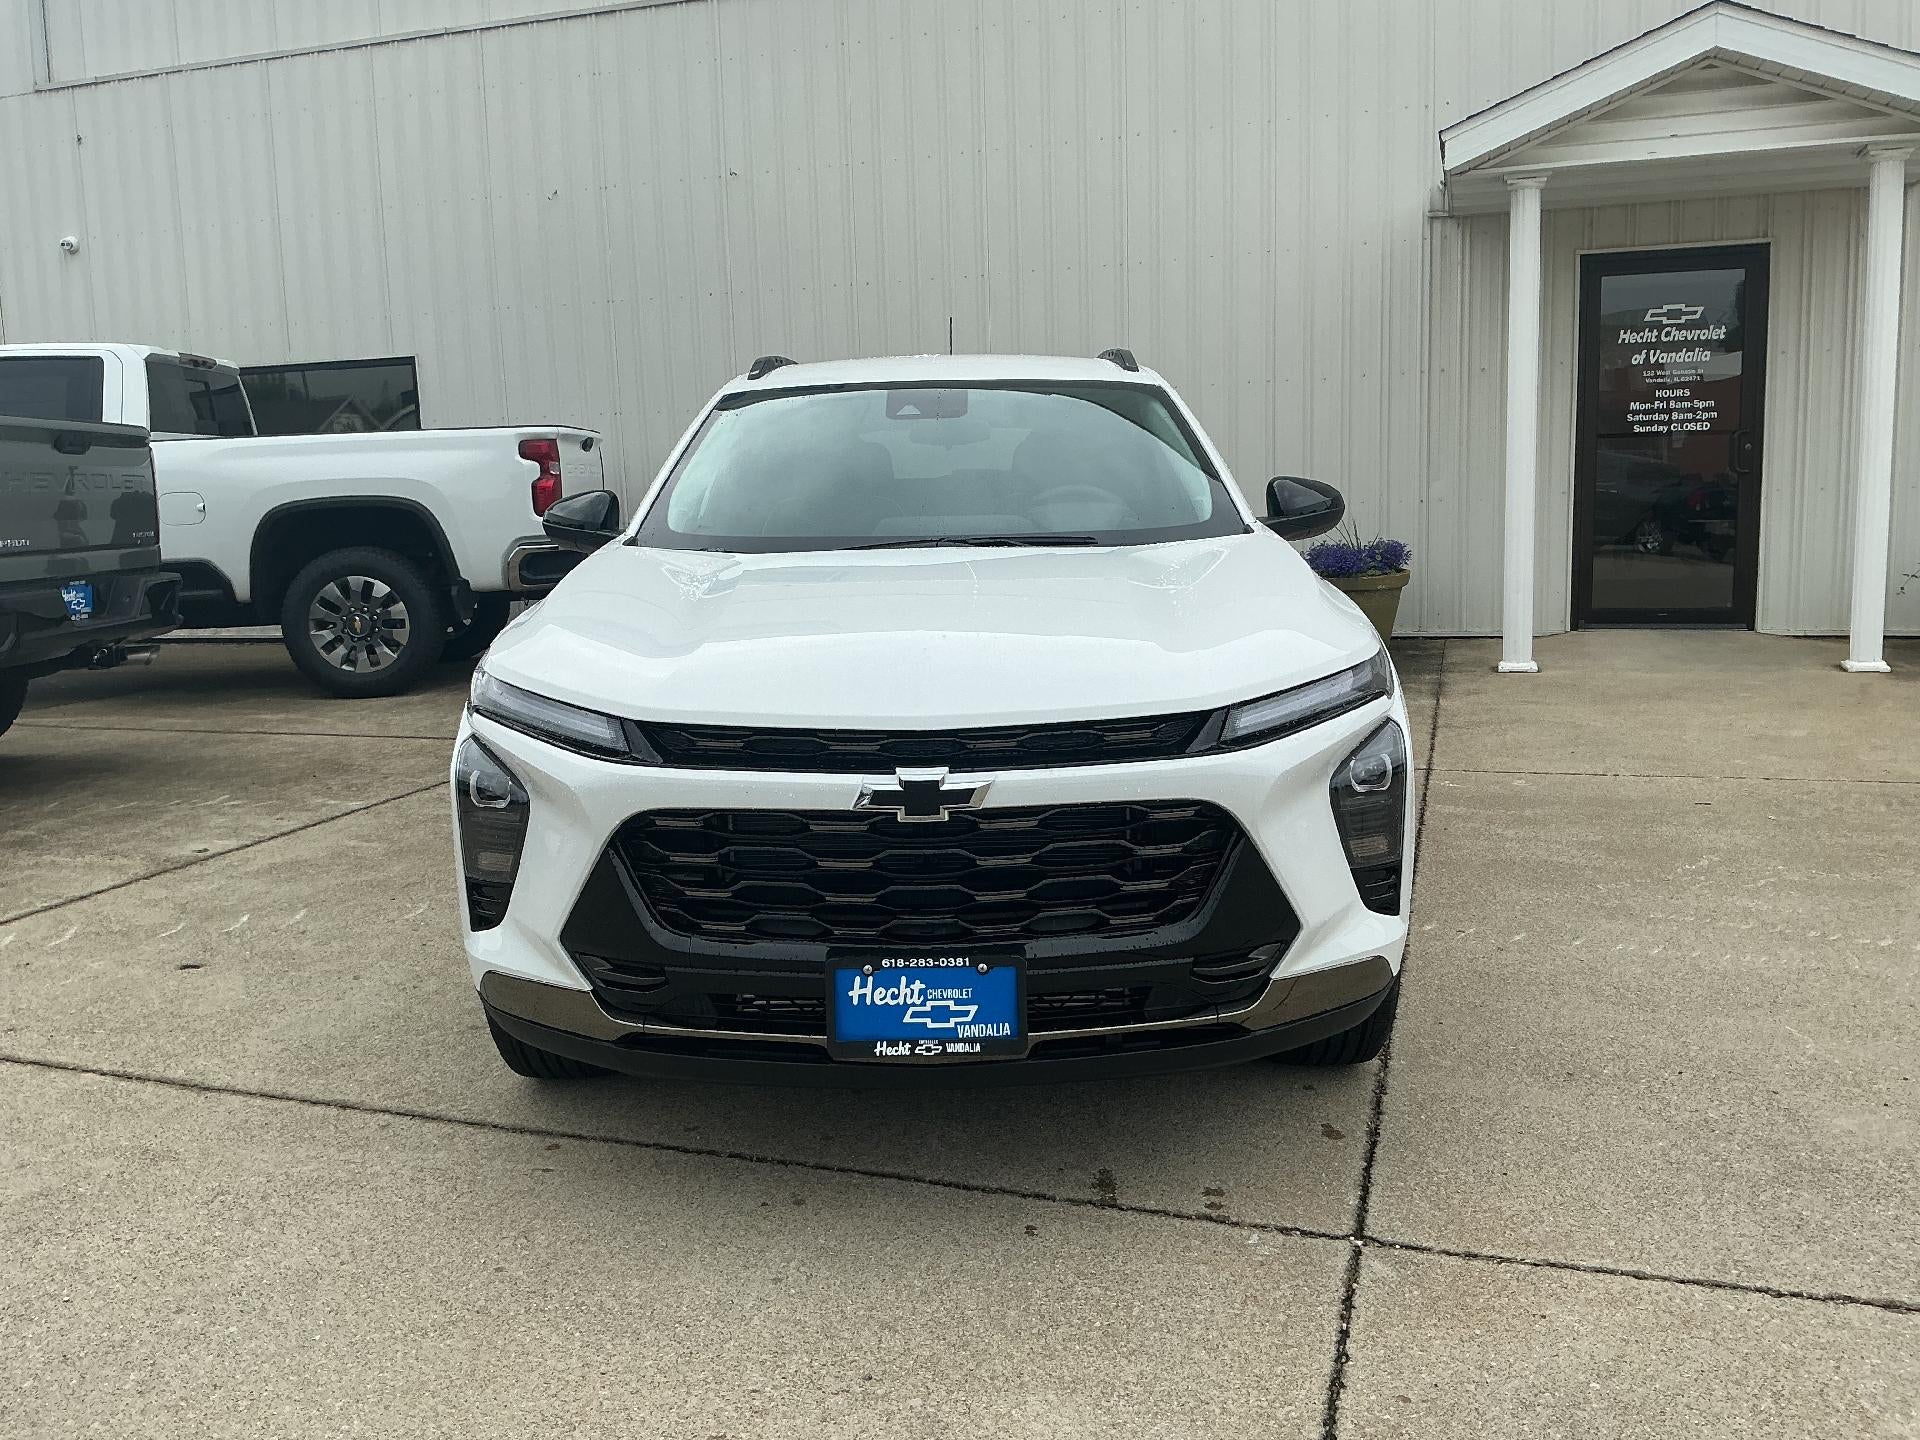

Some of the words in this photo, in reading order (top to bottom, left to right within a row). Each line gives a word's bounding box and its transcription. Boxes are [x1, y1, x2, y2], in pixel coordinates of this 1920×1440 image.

[1618, 328, 1659, 344] Hecht
[1661, 325, 1727, 342] Chevrolet
[1631, 349, 1647, 365] of
[1649, 348, 1711, 364] Vandalia
[1655, 388, 1691, 398] HOURS
[1629, 401, 1667, 411] Mon-Fri
[1669, 399, 1715, 410] 8am-5pm
[1626, 412, 1670, 422] Saturday
[1671, 410, 1718, 420] 8am-2pm
[1633, 424, 1669, 434] Sunday
[1670, 421, 1711, 431] CLOSED
[0, 470, 147, 492] HEVROLET
[881, 957, 970, 968] 618-283-0381
[848, 975, 926, 1006] Hecht
[927, 988, 973, 999] CHEVROLET
[957, 1022, 1011, 1039] VANDALIA
[873, 1040, 912, 1057] Hecht
[945, 1042, 981, 1053] VANDALIA
